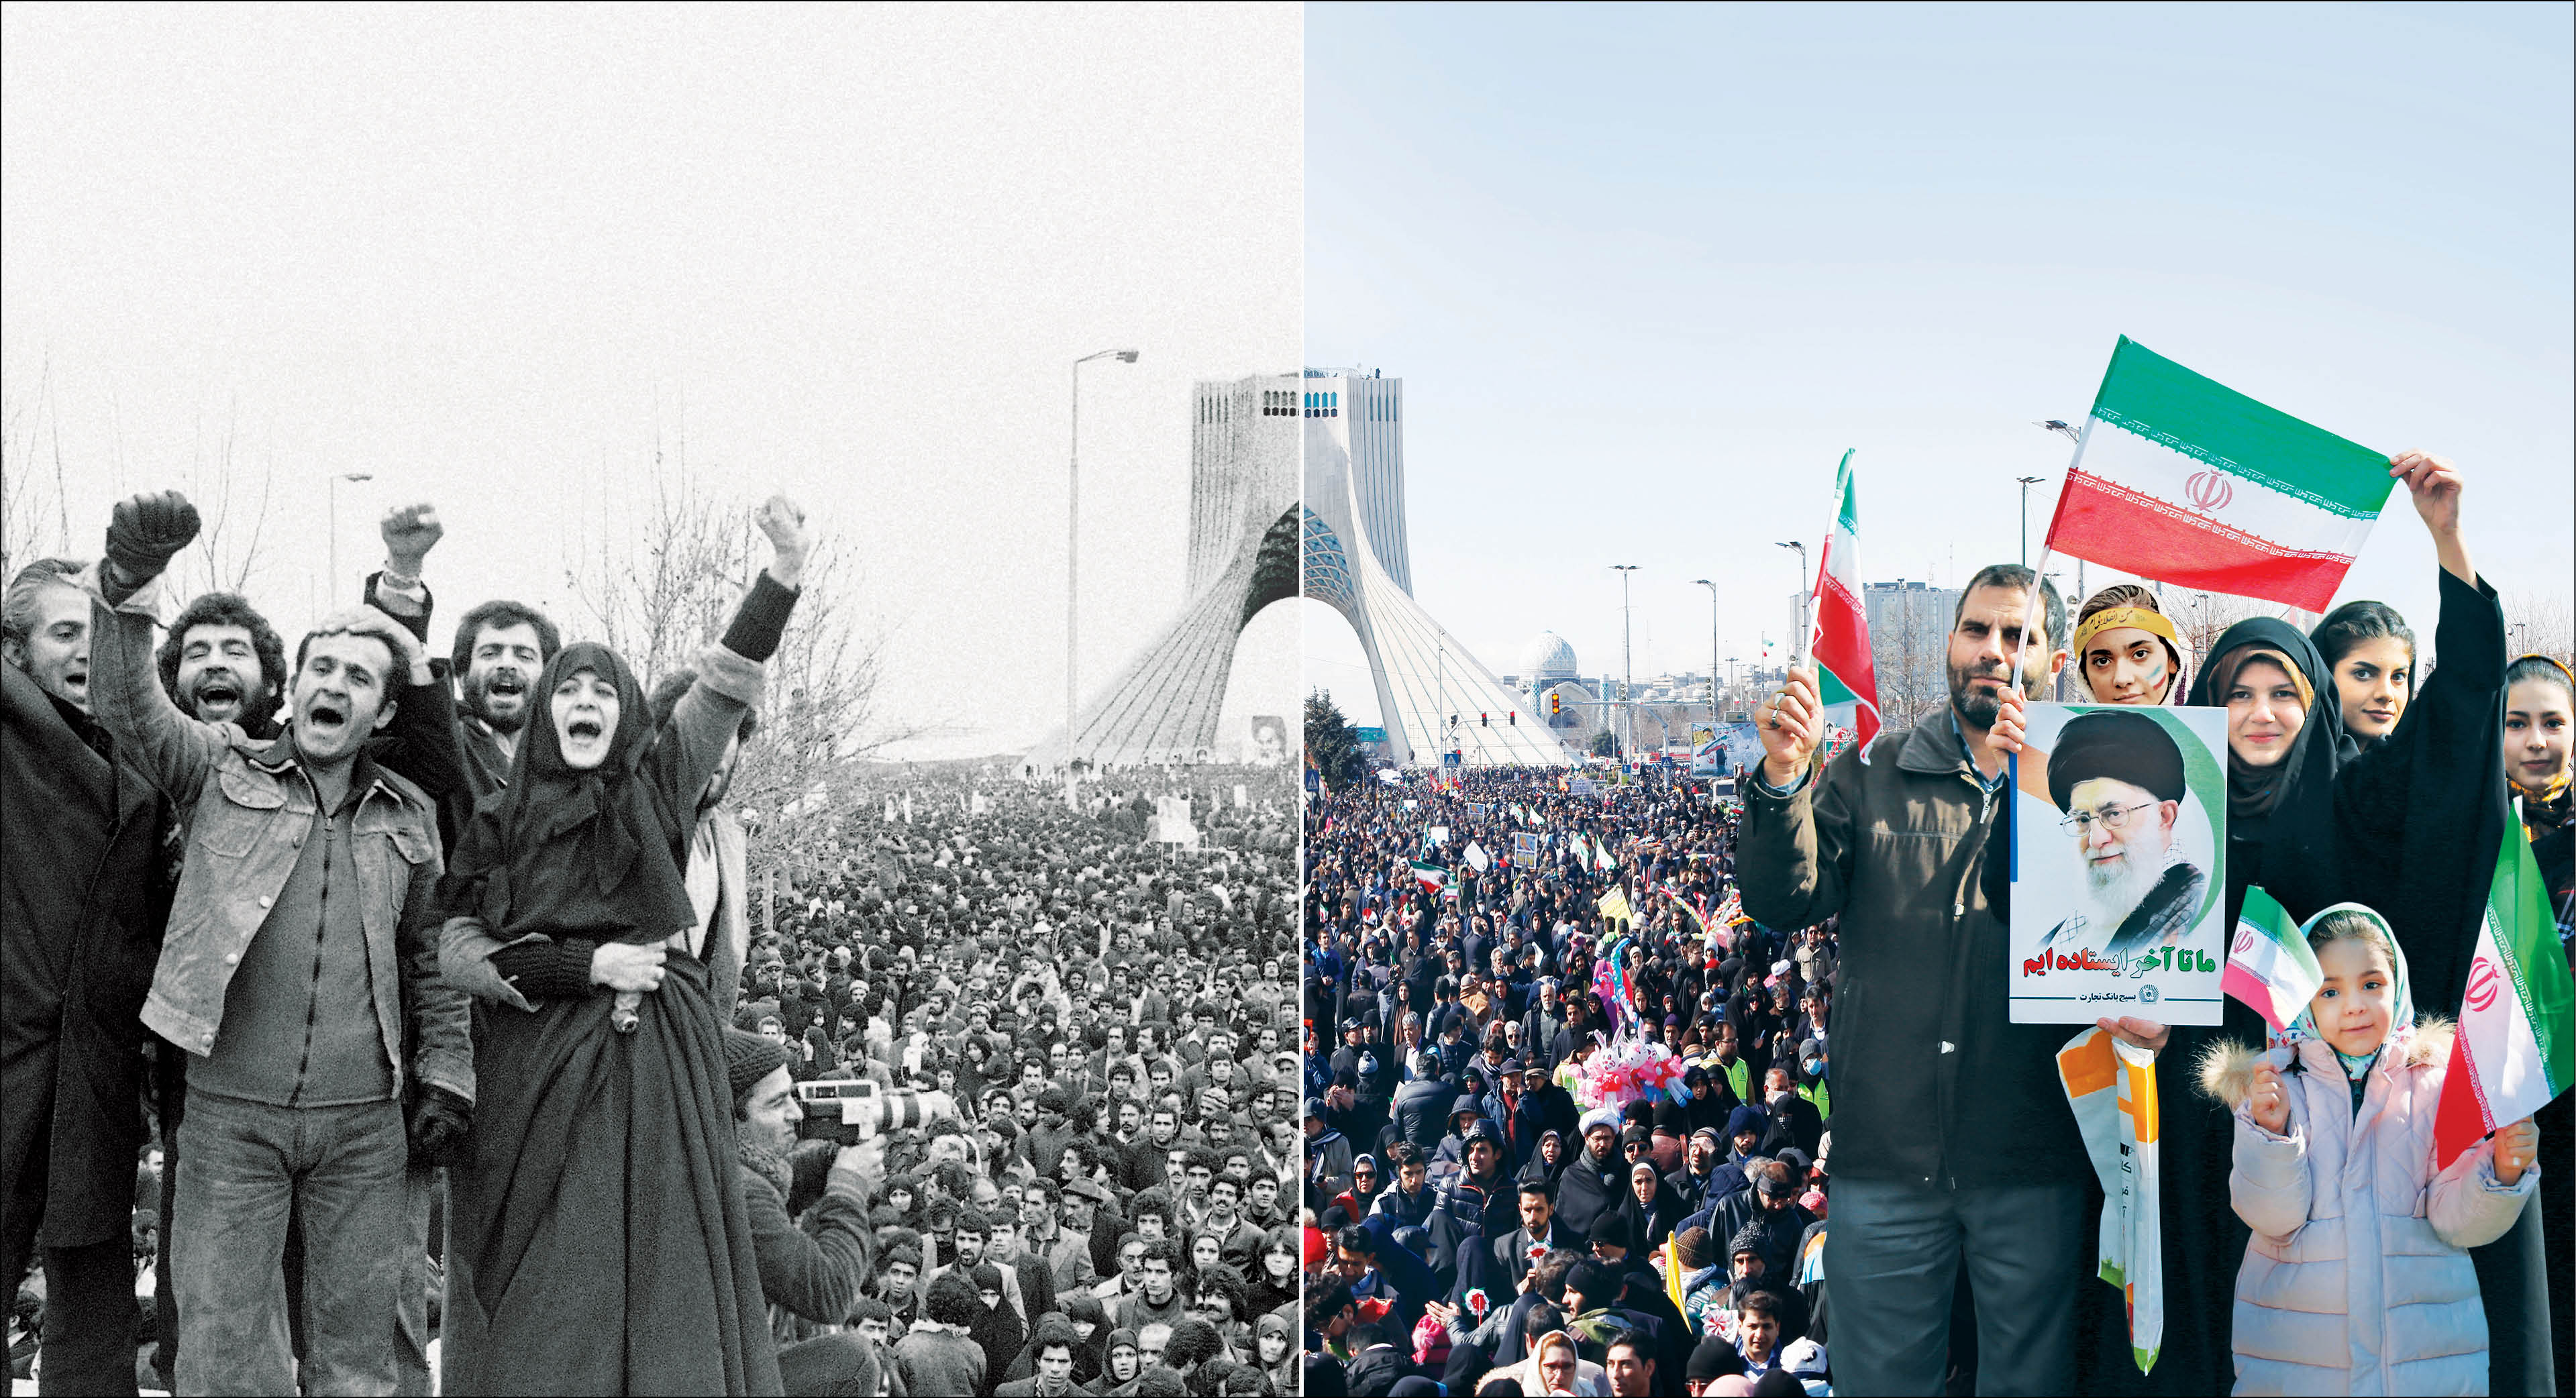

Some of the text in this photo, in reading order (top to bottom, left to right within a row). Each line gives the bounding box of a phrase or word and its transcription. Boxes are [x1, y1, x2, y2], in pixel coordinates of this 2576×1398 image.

[2119, 609, 2133, 623] من
[2023, 947, 2053, 977] ایم
[2056, 947, 2128, 977] ایستاده
[2130, 946, 2175, 979] آخر
[2177, 949, 2194, 972] تا
[2196, 949, 2216, 972] ما
[2079, 992, 2136, 1003] بسیج بانک تجارت
